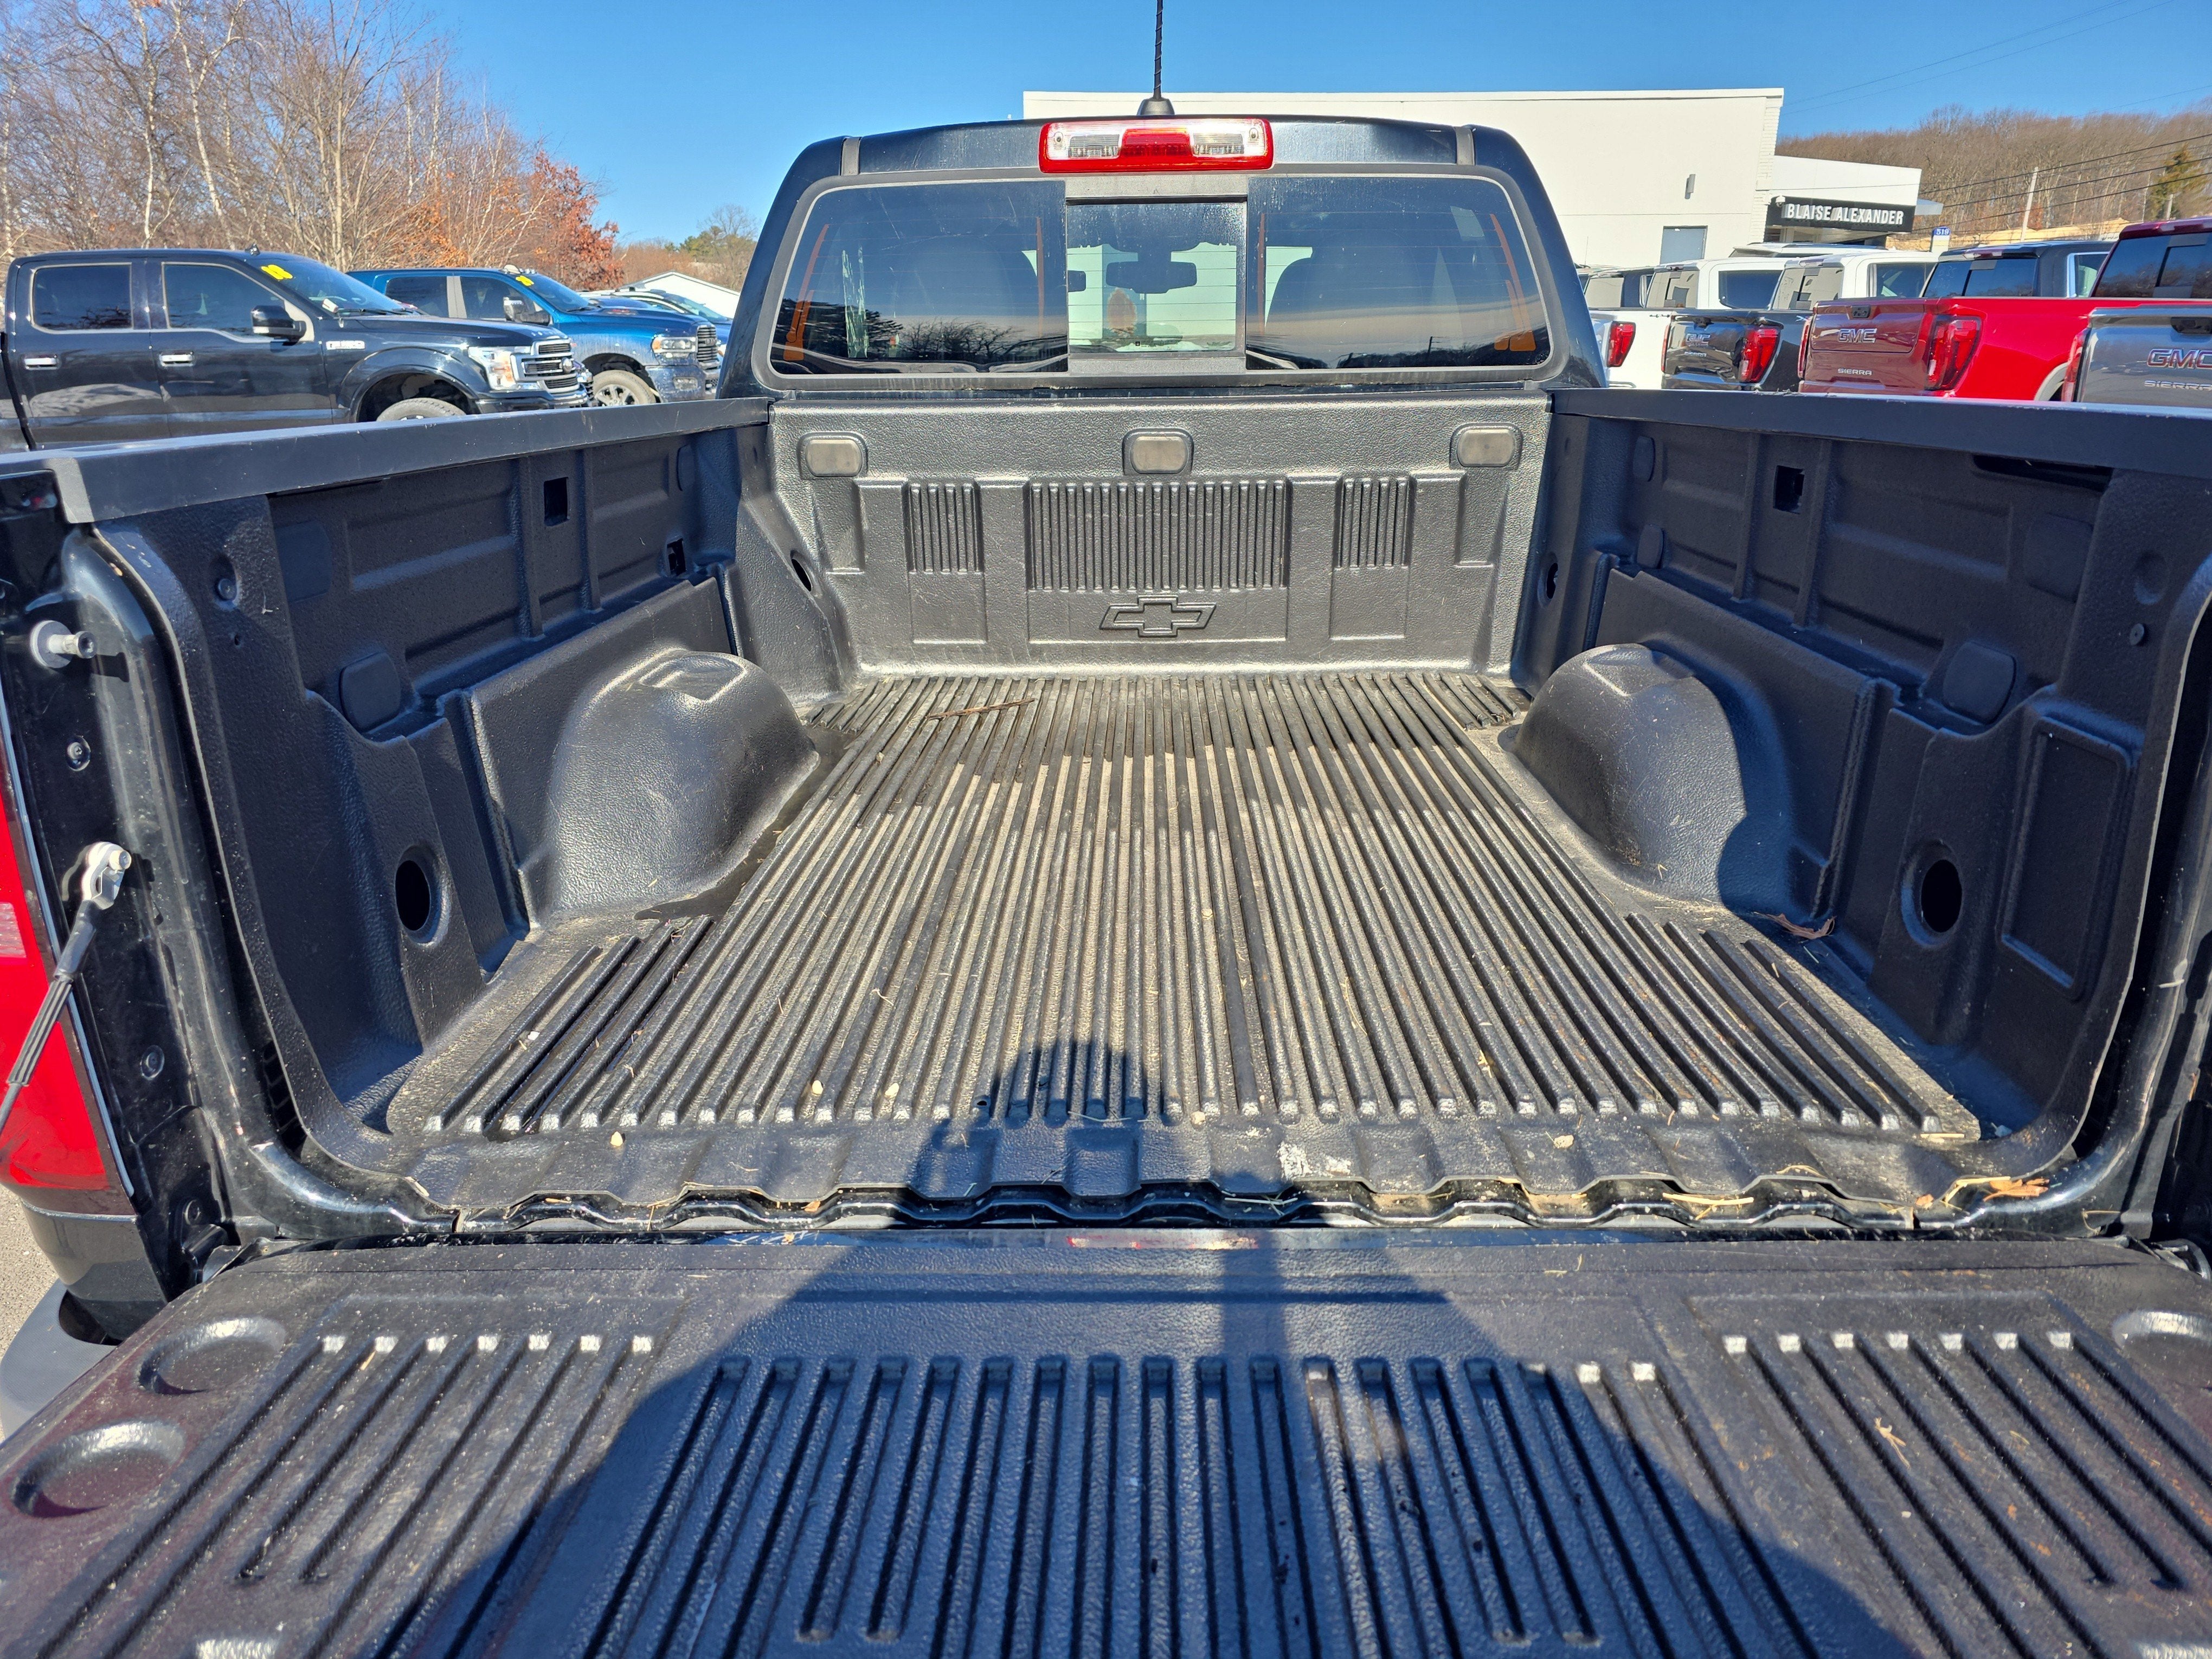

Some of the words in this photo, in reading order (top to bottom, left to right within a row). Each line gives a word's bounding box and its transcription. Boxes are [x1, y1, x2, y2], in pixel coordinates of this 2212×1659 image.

[1785, 203, 1832, 221] BLAISE
[1831, 206, 1905, 225] ALEXANDER
[1838, 328, 1877, 343] GMC
[2144, 380, 2212, 391] SIERRA
